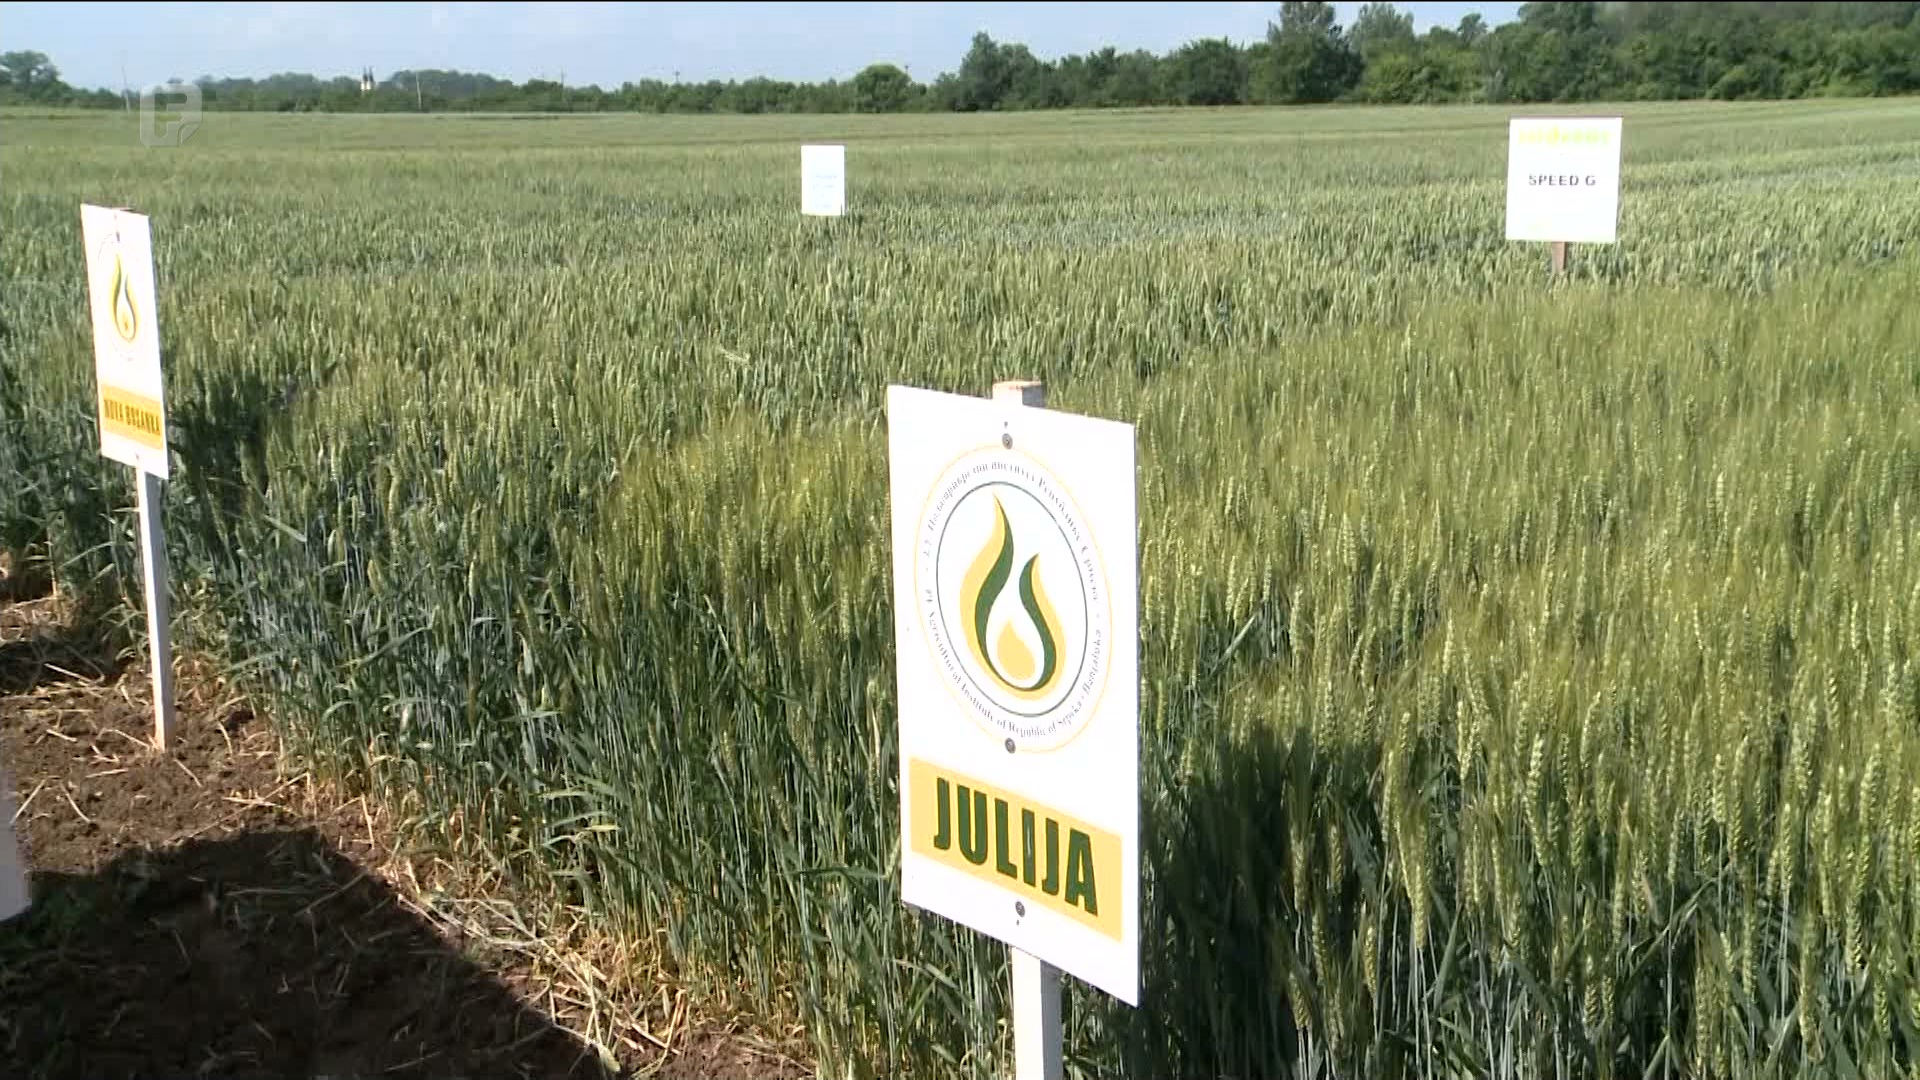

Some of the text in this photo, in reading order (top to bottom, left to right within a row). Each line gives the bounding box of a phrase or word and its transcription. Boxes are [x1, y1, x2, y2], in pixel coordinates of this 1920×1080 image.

[1528, 174, 1596, 186] SPEED G
[933, 776, 1099, 916] JULIJA
